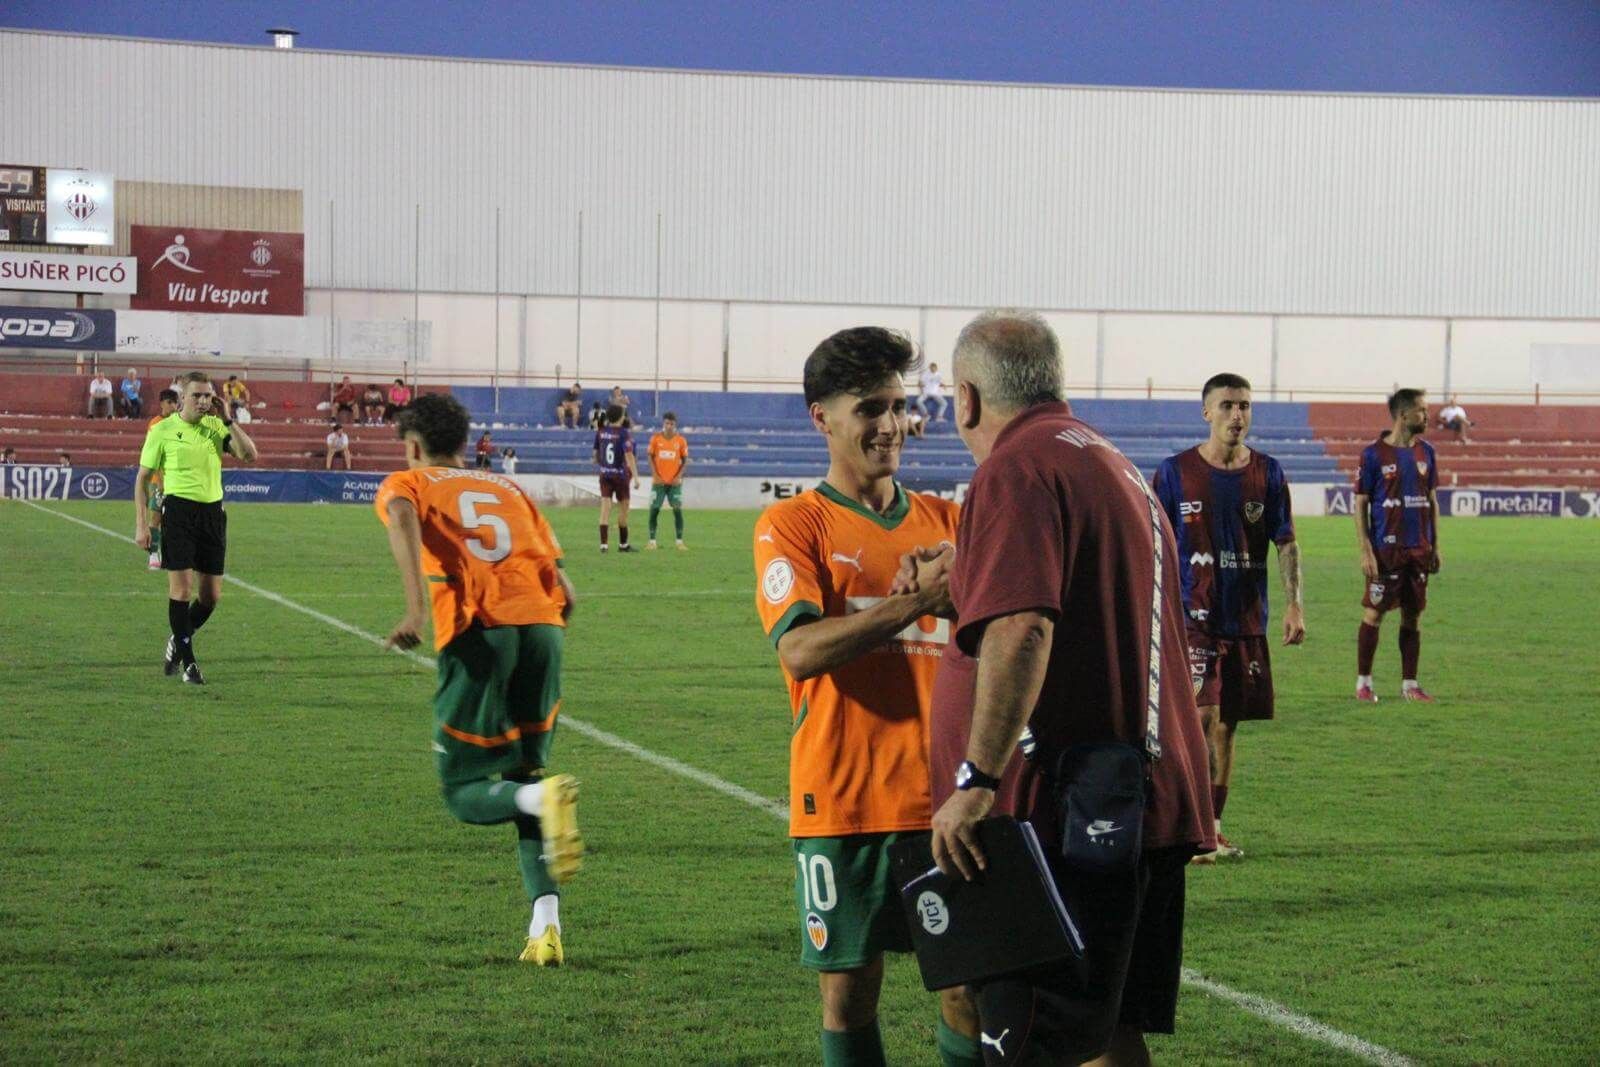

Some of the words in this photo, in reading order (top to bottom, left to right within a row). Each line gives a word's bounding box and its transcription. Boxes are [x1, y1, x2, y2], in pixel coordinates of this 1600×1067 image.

[6, 199, 46, 212] VISITANTE
[1, 259, 69, 281] SUÑER
[76, 262, 126, 283] PICÓ
[167, 282, 196, 302] Viu
[200, 283, 269, 308] l'esport
[606, 443, 615, 465] 6
[224, 484, 270, 494] academy
[343, 481, 384, 490] ACADEM
[342, 492, 355, 500] DE
[458, 490, 512, 562] 5
[924, 646, 943, 657] Grou
[1090, 836, 1115, 847] AIR
[798, 853, 838, 912] 10
[922, 898, 943, 929] VCF
